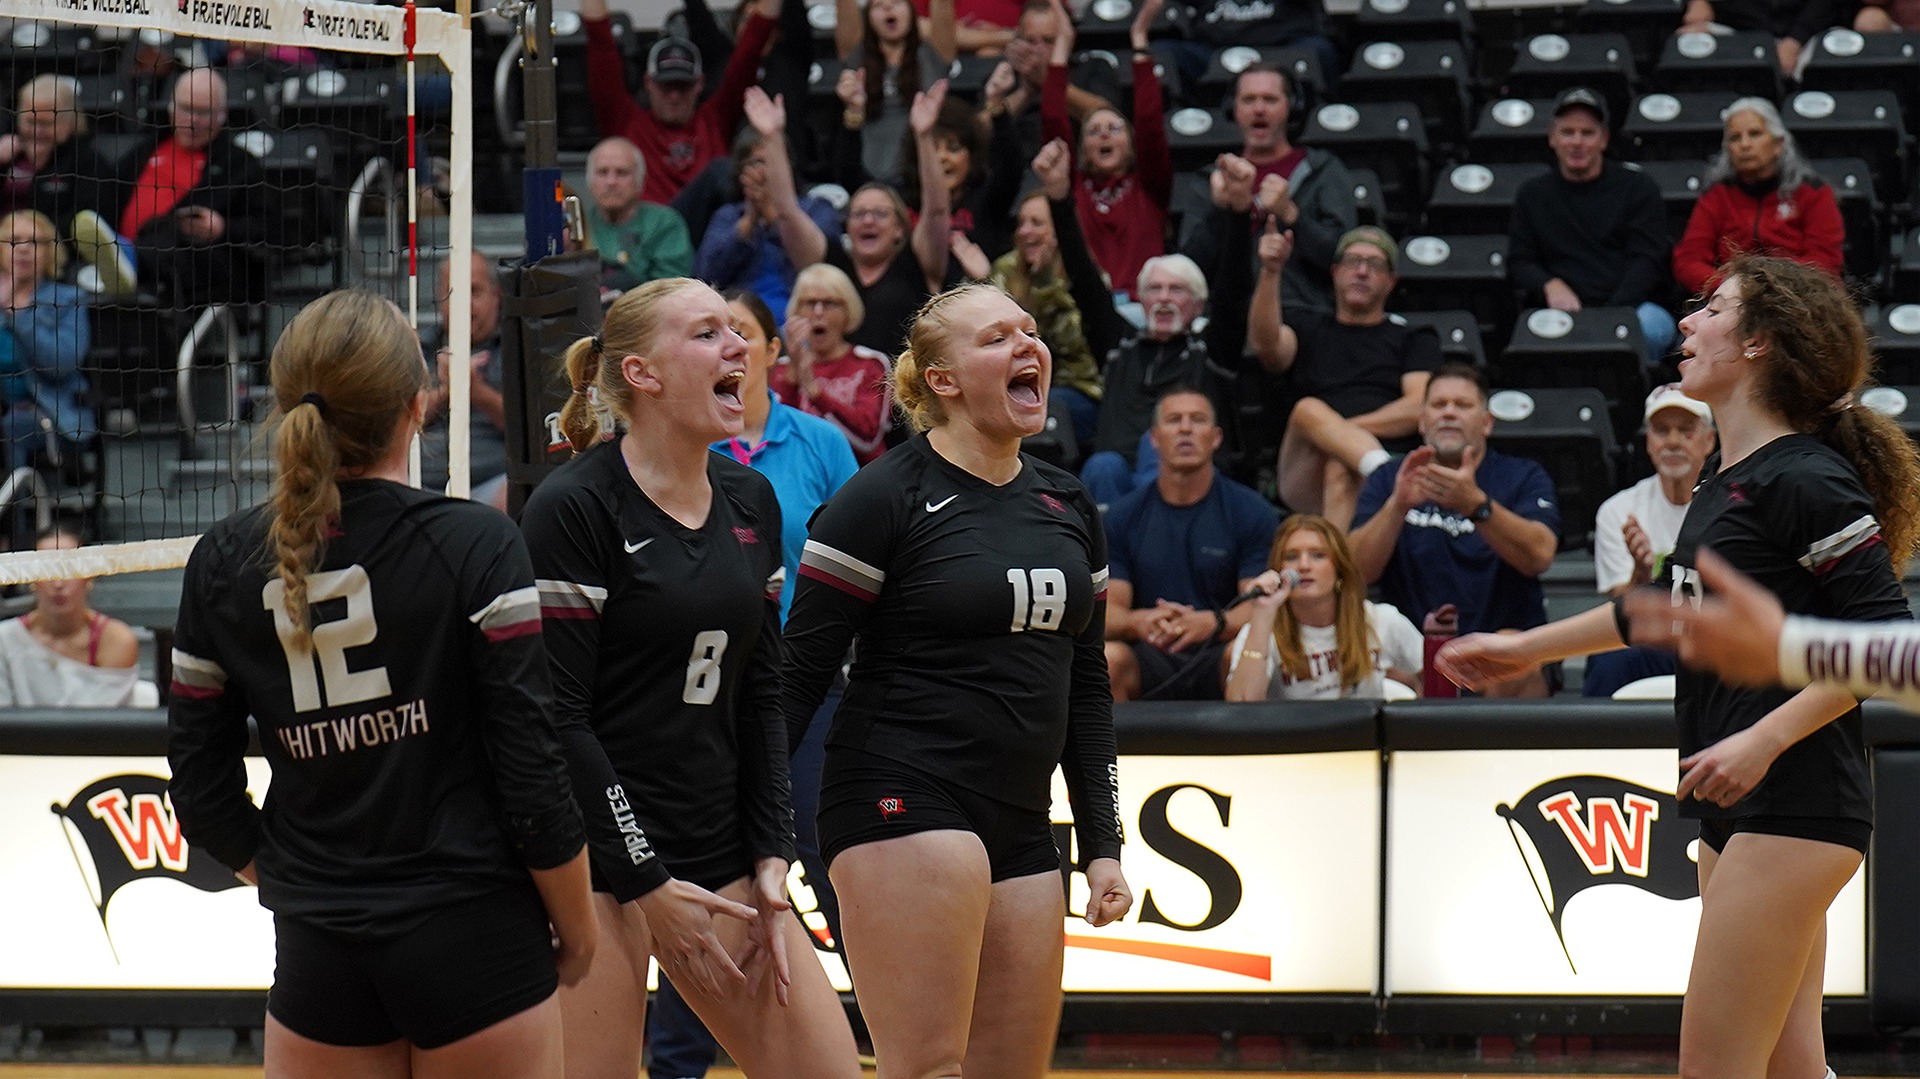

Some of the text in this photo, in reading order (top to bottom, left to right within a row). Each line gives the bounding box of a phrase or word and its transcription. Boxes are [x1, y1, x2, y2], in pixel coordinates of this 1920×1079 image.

[262, 564, 392, 713] 12
[1007, 567, 1067, 633] 18
[682, 630, 729, 705] 8
[1804, 637, 1851, 683] GO
[87, 787, 190, 871] W
[605, 784, 656, 866] PIRATES
[1538, 790, 1660, 878] W
